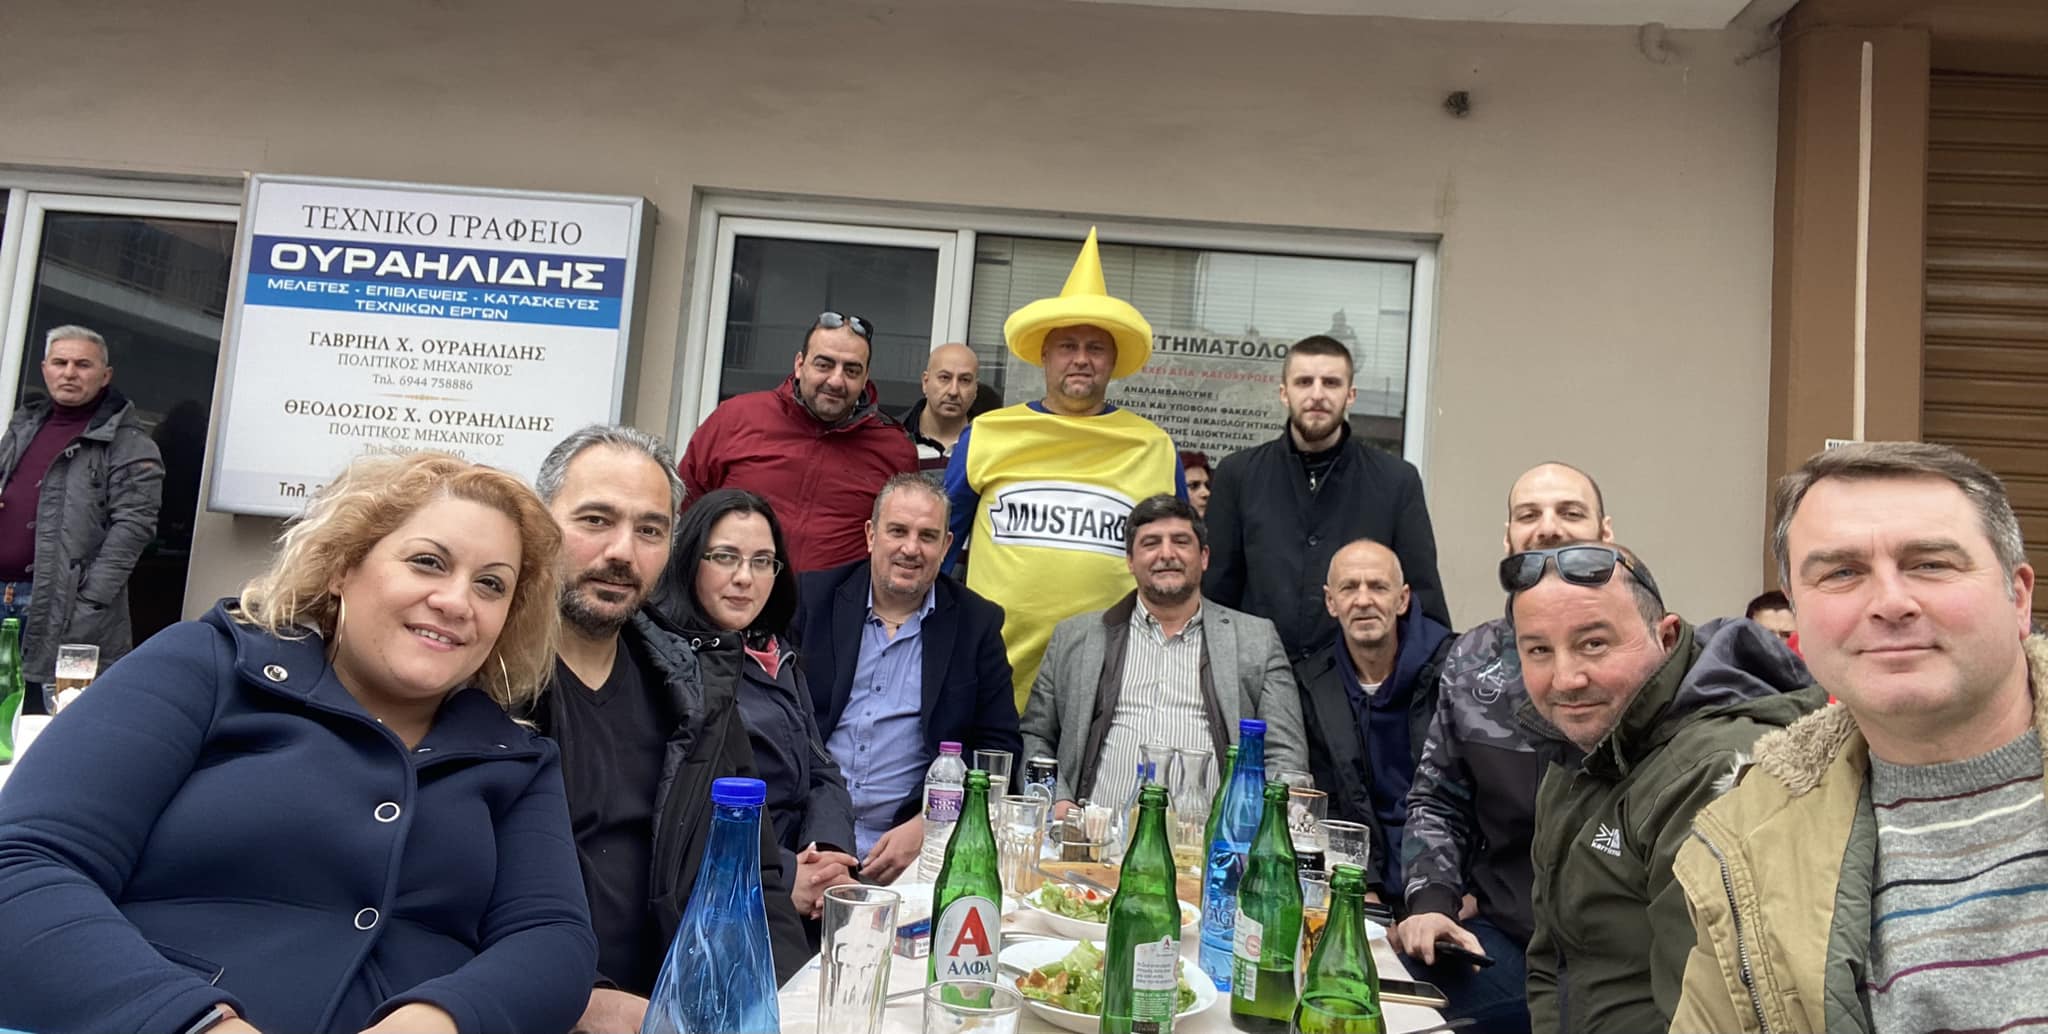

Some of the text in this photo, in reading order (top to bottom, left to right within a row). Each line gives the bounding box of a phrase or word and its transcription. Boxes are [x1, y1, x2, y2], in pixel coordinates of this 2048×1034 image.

[302, 205, 583, 246] ΤΕΧΝΙΚΟ ΓΡΑΦΕΙΟ
[270, 242, 606, 291] ΟΥΡΑΗΛΙΔΗΣ
[267, 277, 350, 294] ΜΕΛΕΤΕΣ
[366, 284, 468, 303] ΕΠΙΒΛΕΨΕΙΣ
[484, 292, 600, 311] ΚΑΤΑΣΚΕΥΕΣ
[355, 299, 509, 320] ΤΕΧΝΙΚΩΝ ΕΡΓΩΝ
[308, 330, 547, 361] ΓΑΒΡΙΗΛ Χ. ΟΥΡΑΗΛΙΔΗΣ
[1152, 334, 1288, 359] ΤΗΜΑΤΟΛΟ
[337, 353, 513, 377] ΠΟΛΙΤΙΚΟΣ ΜΗΧΑΝΙΚΟΣ
[372, 373, 473, 391] Τηλ. 6944 758886
[284, 398, 555, 432] ΘΕΟΔΟΣΙΟΣ Χ. ΟΥΡΑΗΛΙΔΗΣ
[1149, 401, 1166, 409] ΚΑΙ
[328, 422, 505, 447] ΠΟΛΙΤΙΚΟΣ ΜΗΧΑΝΙΚΟΣ
[279, 481, 309, 498] Τηλ.
[947, 959, 992, 976] ΑΛΦΑ
